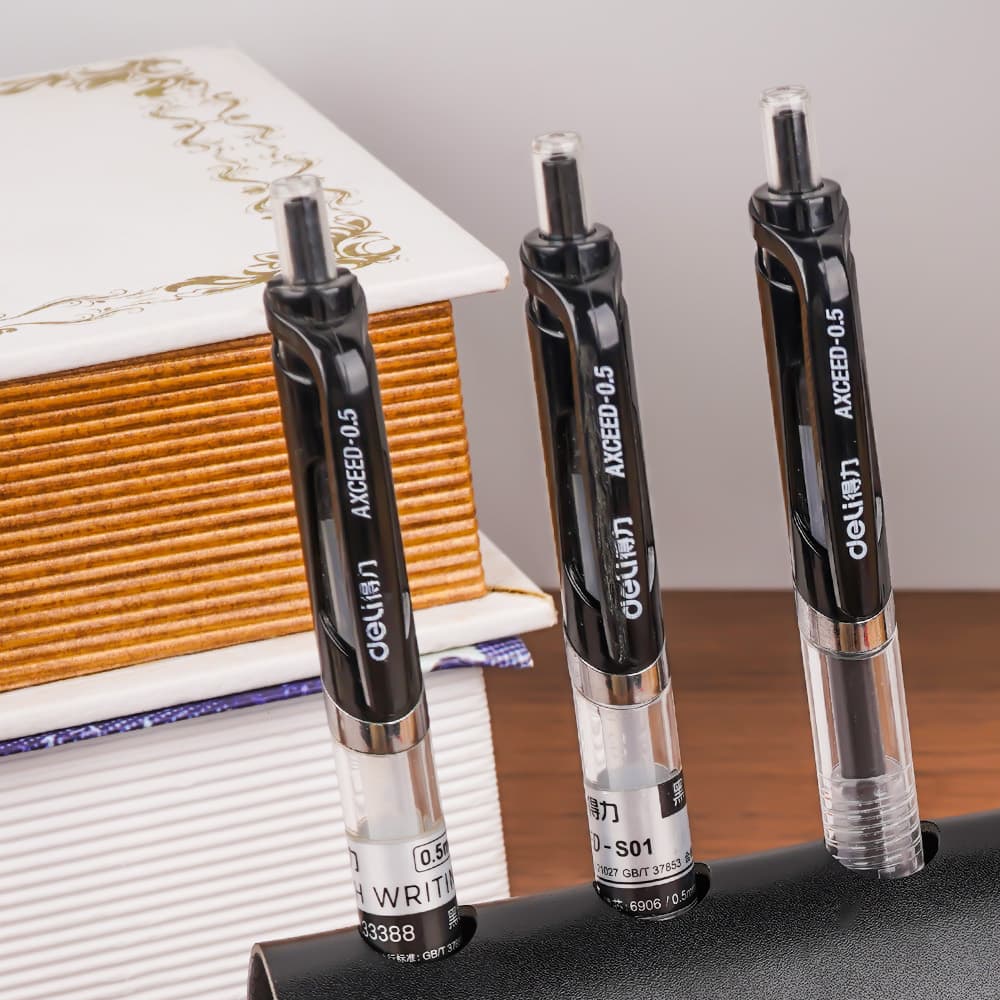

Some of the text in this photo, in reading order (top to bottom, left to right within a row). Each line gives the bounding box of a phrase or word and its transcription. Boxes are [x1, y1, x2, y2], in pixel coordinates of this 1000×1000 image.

[826, 308, 853, 419] AXCEED-0.5
[594, 365, 625, 478] AXCEED-0.5
[337, 408, 372, 519] AXCEED-0.5
[622, 867, 649, 878] GB/T
[652, 858, 682, 875] 37853
[629, 898, 662, 912] 6906
[361, 920, 416, 943] 33388
[422, 947, 446, 962] GB/T
